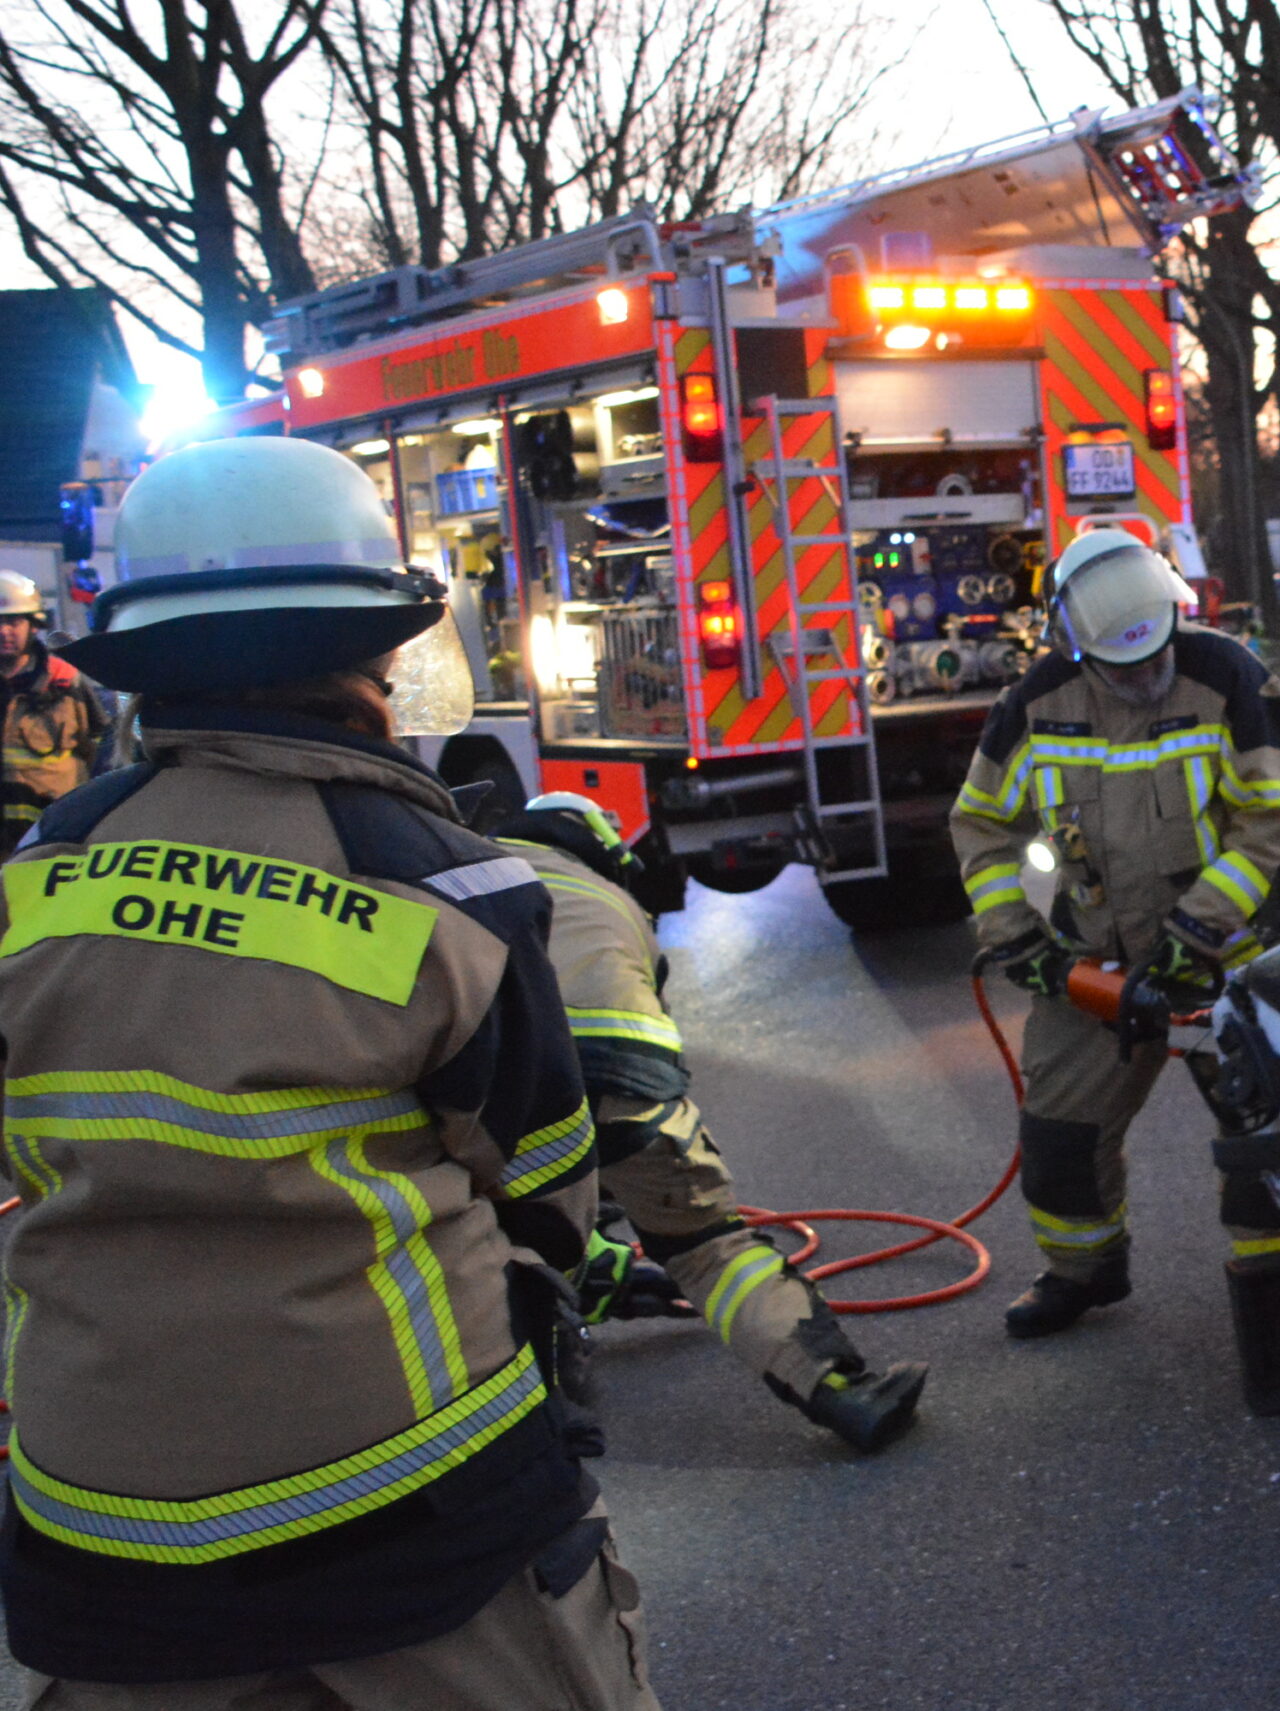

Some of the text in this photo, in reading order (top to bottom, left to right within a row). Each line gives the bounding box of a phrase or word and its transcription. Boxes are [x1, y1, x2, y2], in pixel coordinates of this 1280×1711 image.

[1092, 450, 1114, 468] OD
[1071, 471, 1089, 489] FF
[44, 845, 380, 932] FEUERWEHR
[112, 894, 246, 947] OHE
